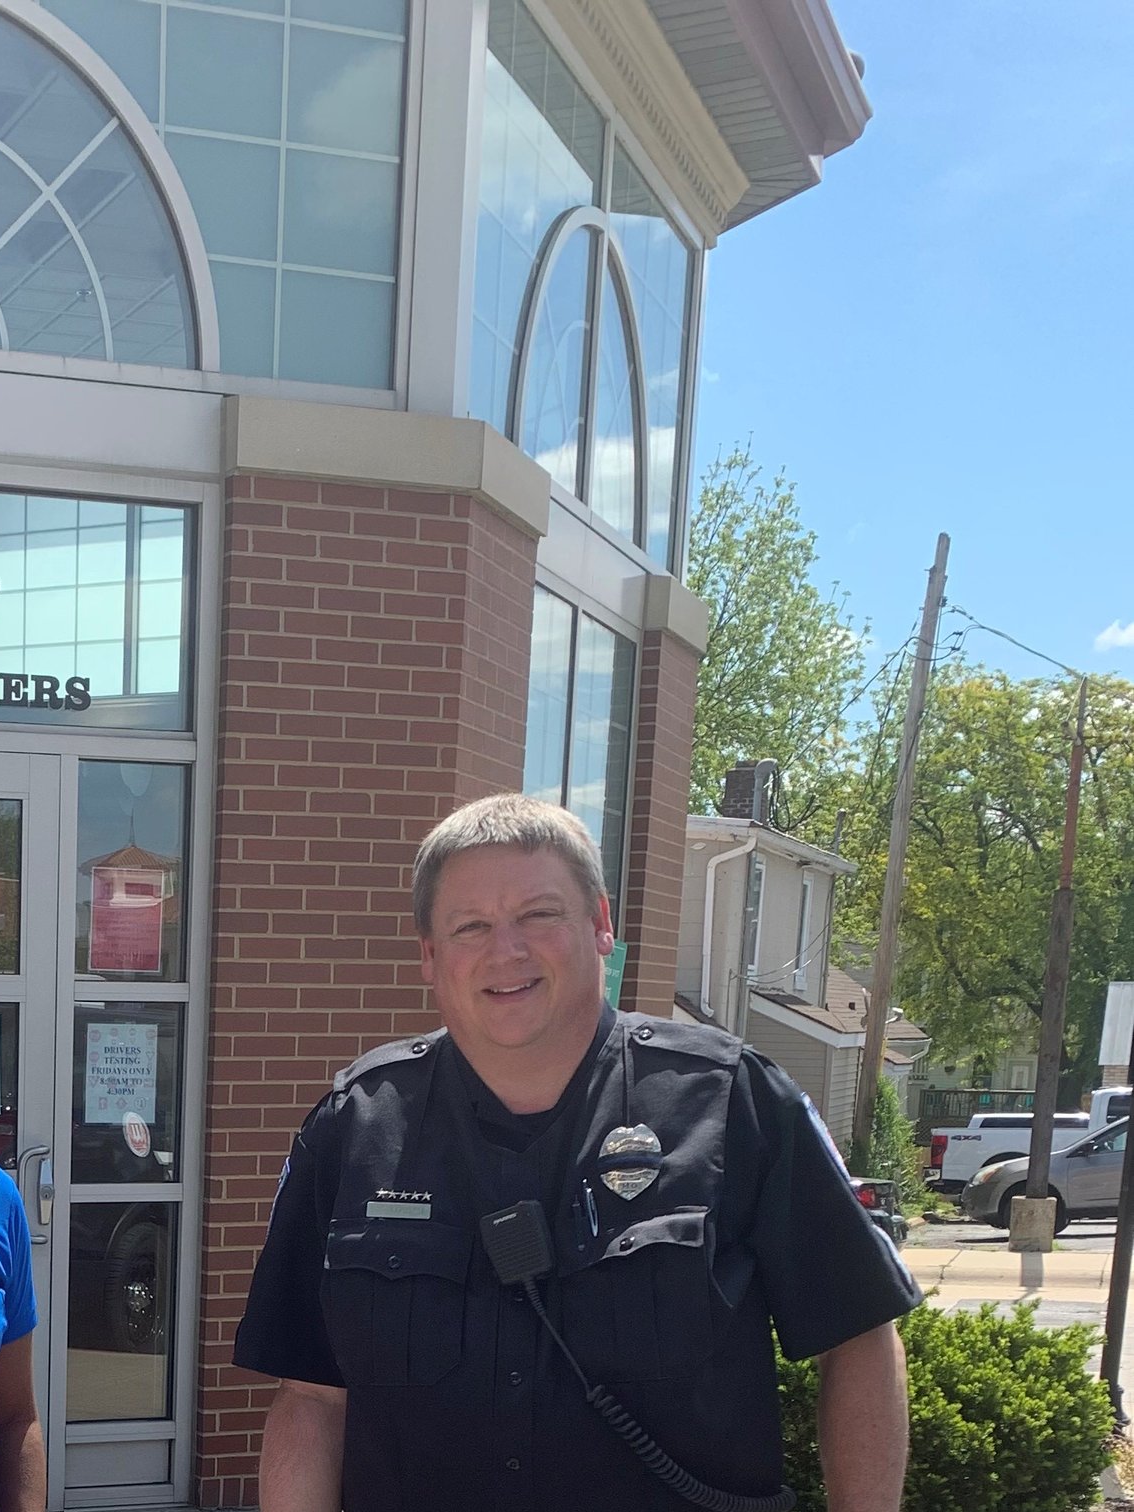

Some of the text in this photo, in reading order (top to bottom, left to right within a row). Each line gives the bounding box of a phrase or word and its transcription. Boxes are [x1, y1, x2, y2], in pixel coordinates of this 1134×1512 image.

[104, 1046, 141, 1055] DRIVERS
[105, 1057, 141, 1065] TESTING
[91, 1067, 151, 1075] FRIDAYS ONLY
